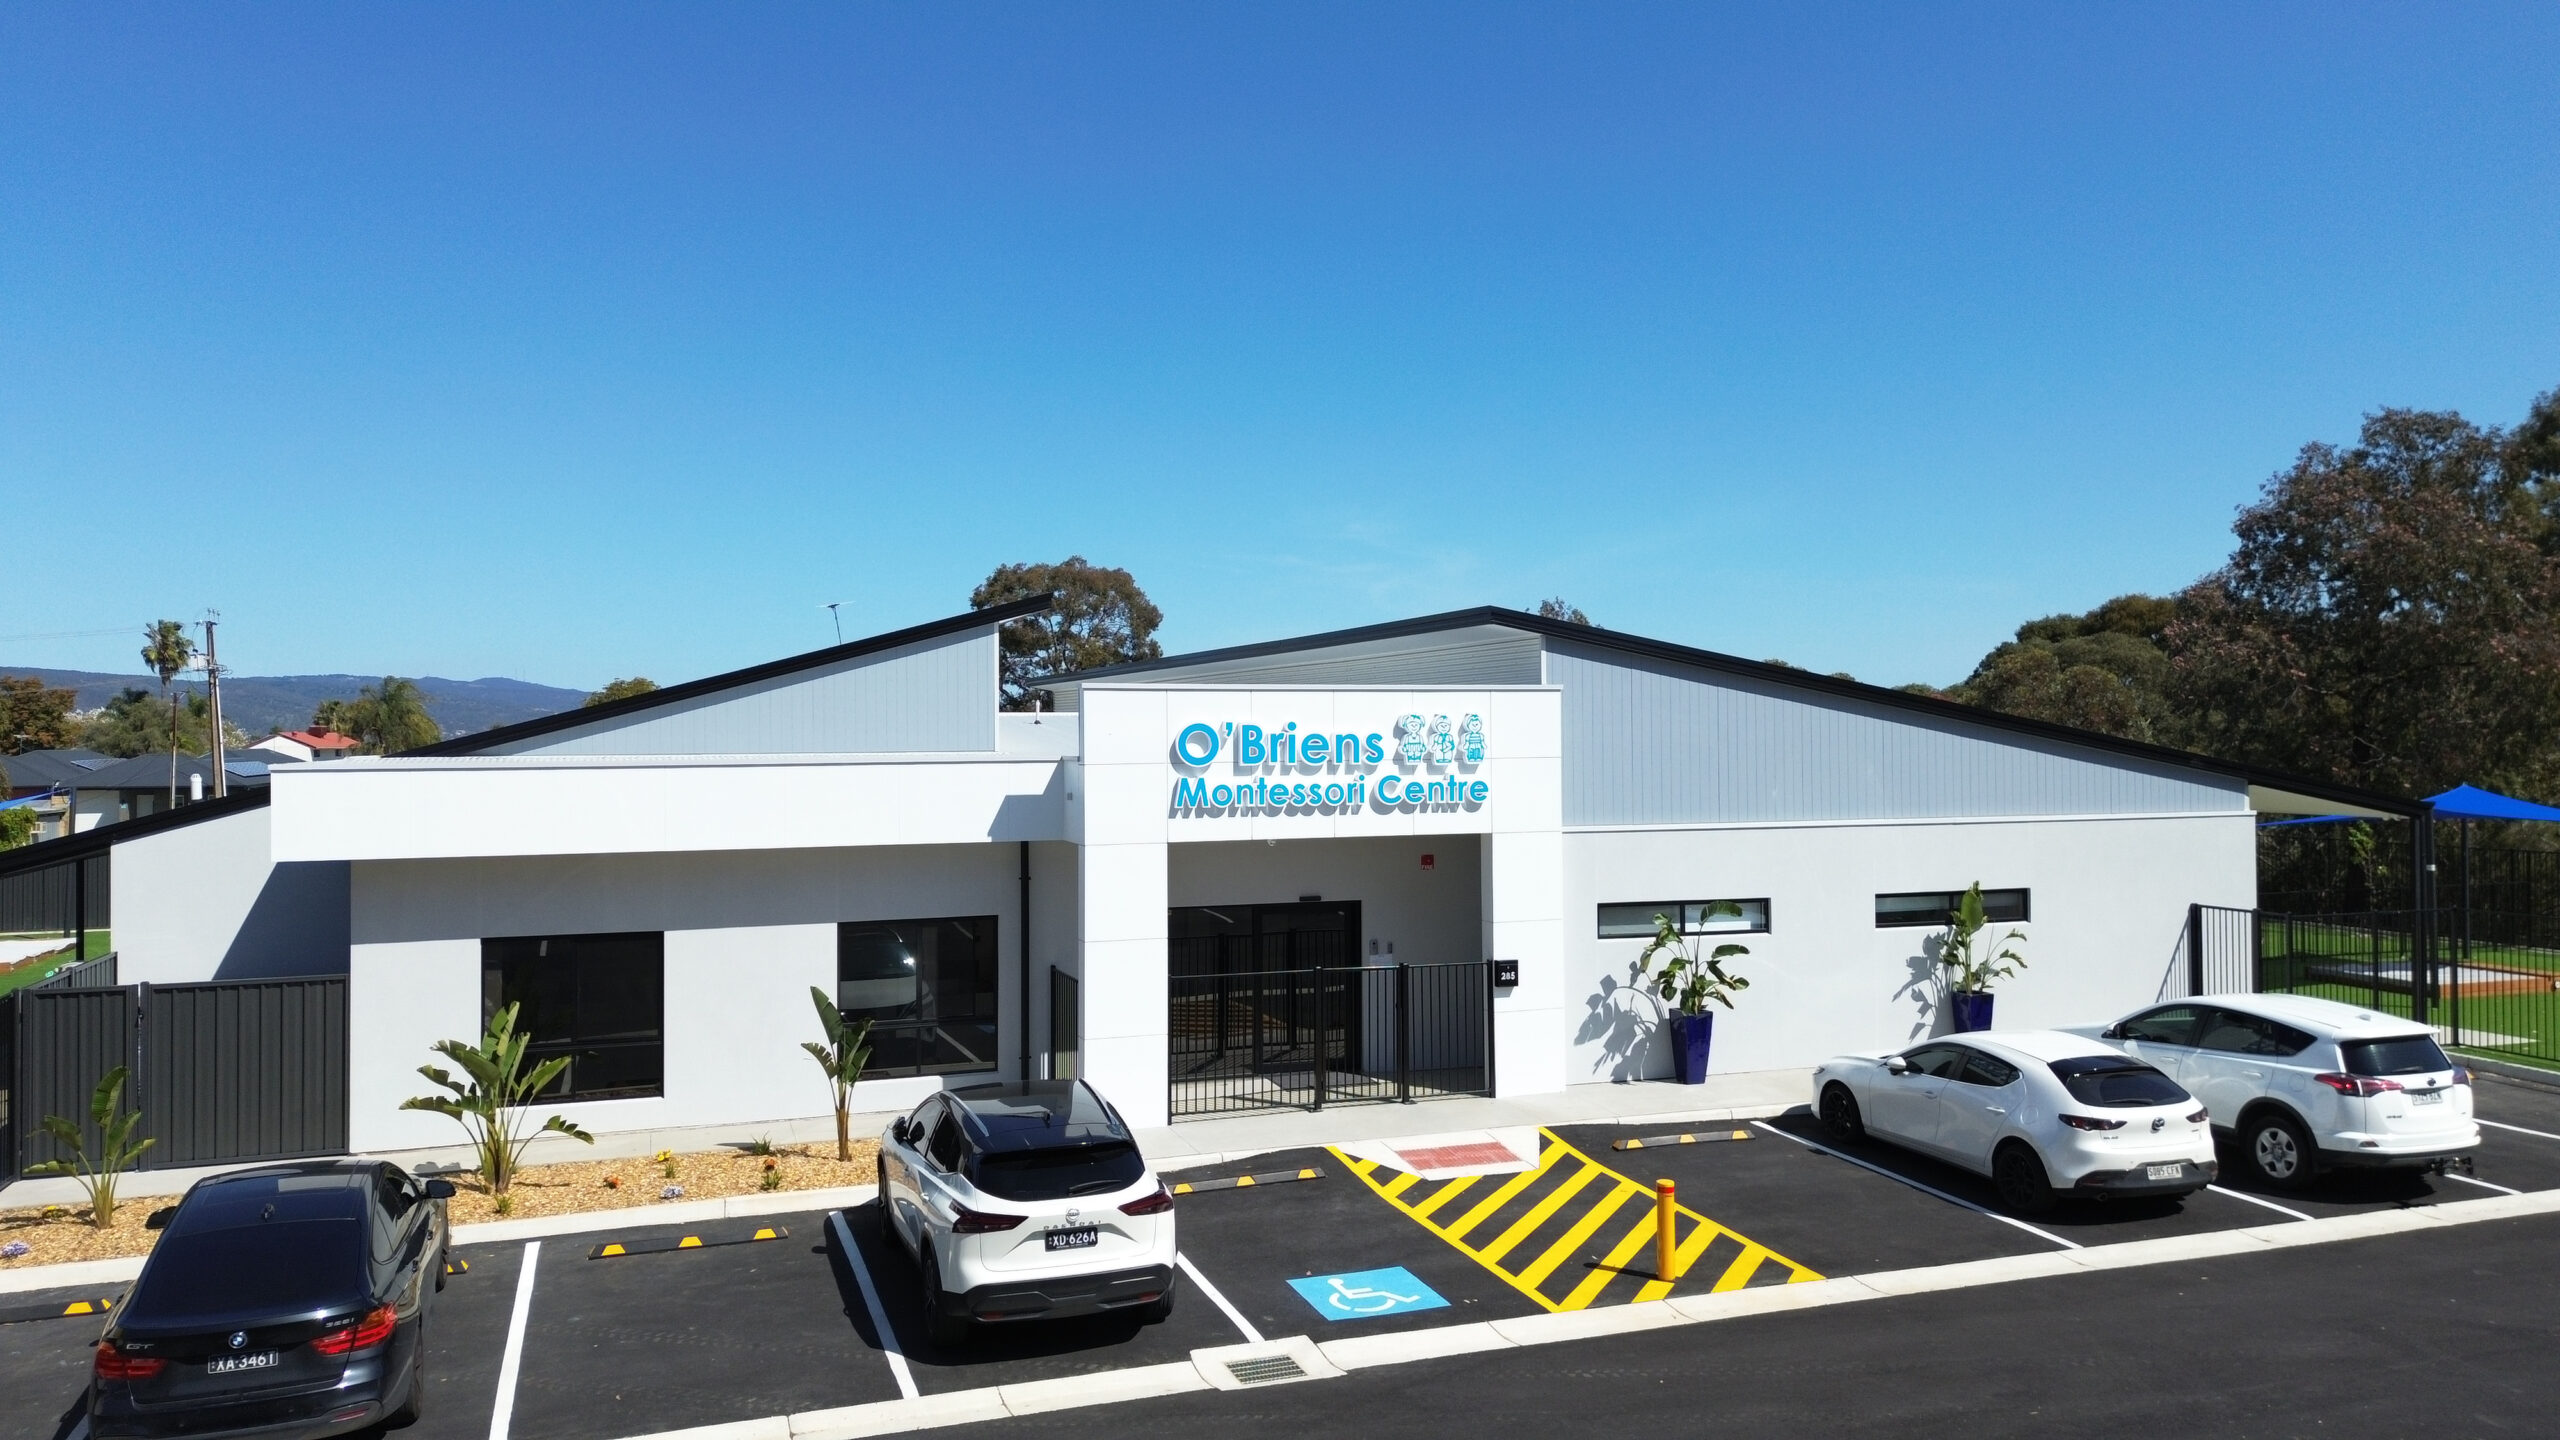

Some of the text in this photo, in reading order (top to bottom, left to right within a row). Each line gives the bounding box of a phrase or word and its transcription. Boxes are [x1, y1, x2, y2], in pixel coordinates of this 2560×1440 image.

[1178, 721, 1385, 766] O'Briens
[1177, 774, 1489, 807] Montessori Centre
